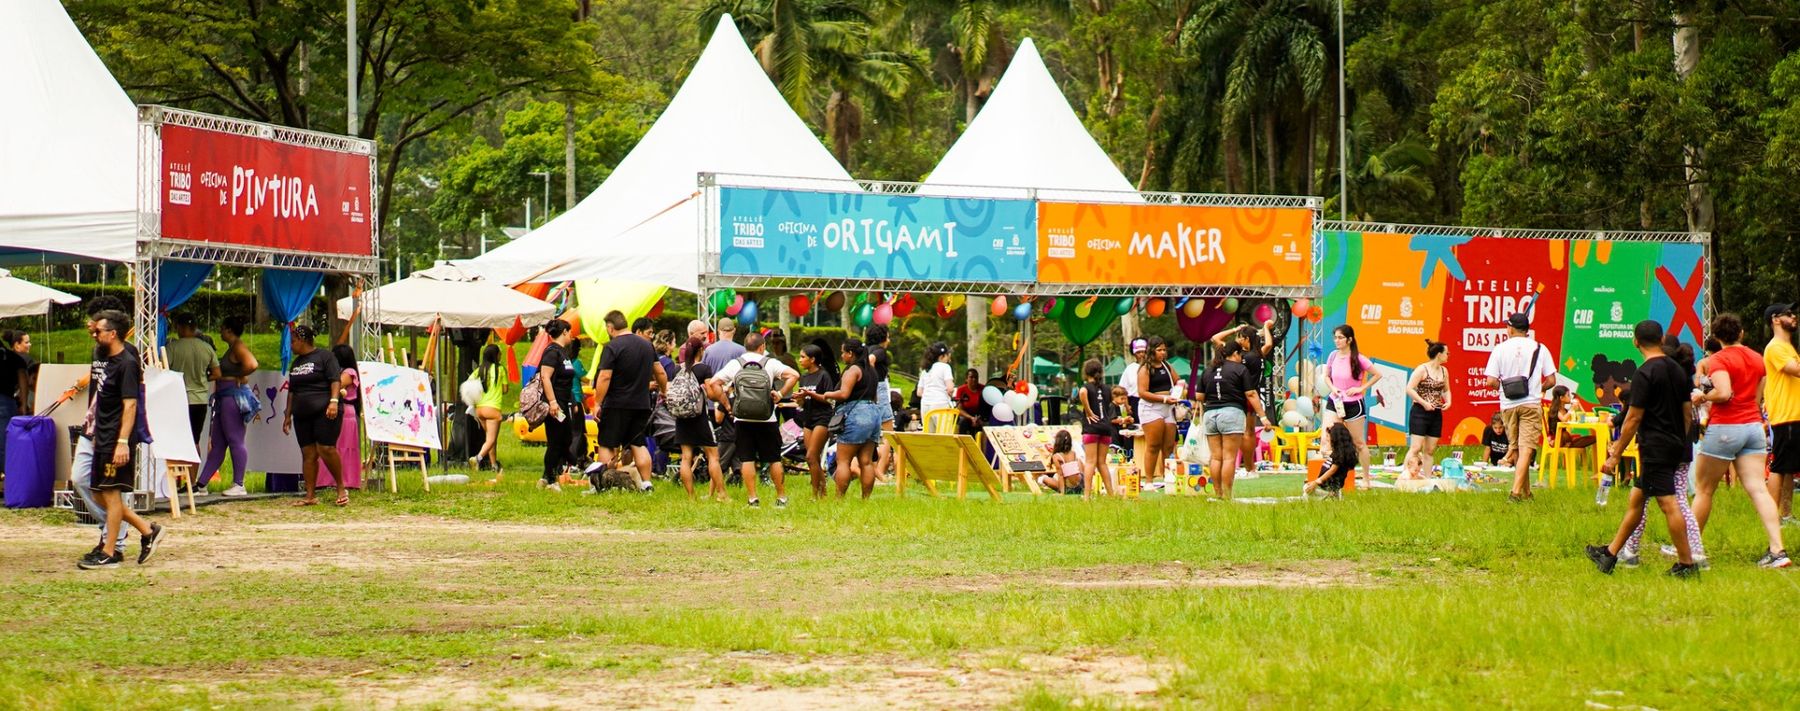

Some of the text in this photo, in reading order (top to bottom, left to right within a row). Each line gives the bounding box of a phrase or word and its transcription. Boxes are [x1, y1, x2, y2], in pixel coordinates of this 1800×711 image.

[170, 172, 191, 190] TRIBO
[200, 171, 228, 188] OFICINA
[219, 190, 227, 206] DE
[232, 165, 319, 220] PINTURA
[733, 222, 764, 236] TRIBO
[778, 221, 817, 234] OFICINA
[807, 234, 817, 248] DE
[823, 218, 959, 258] ORIGAMI
[1048, 234, 1075, 247] TRIBO
[1087, 238, 1121, 250] OFICINA
[1128, 222, 1226, 268] MAKER
[1464, 276, 1533, 293] ATELIÊ
[1463, 294, 1536, 324] TRIBO
[1388, 325, 1424, 335] SÃO PAULO
[1599, 329, 1612, 338] SÃO
[1467, 333, 1490, 347] DAS
